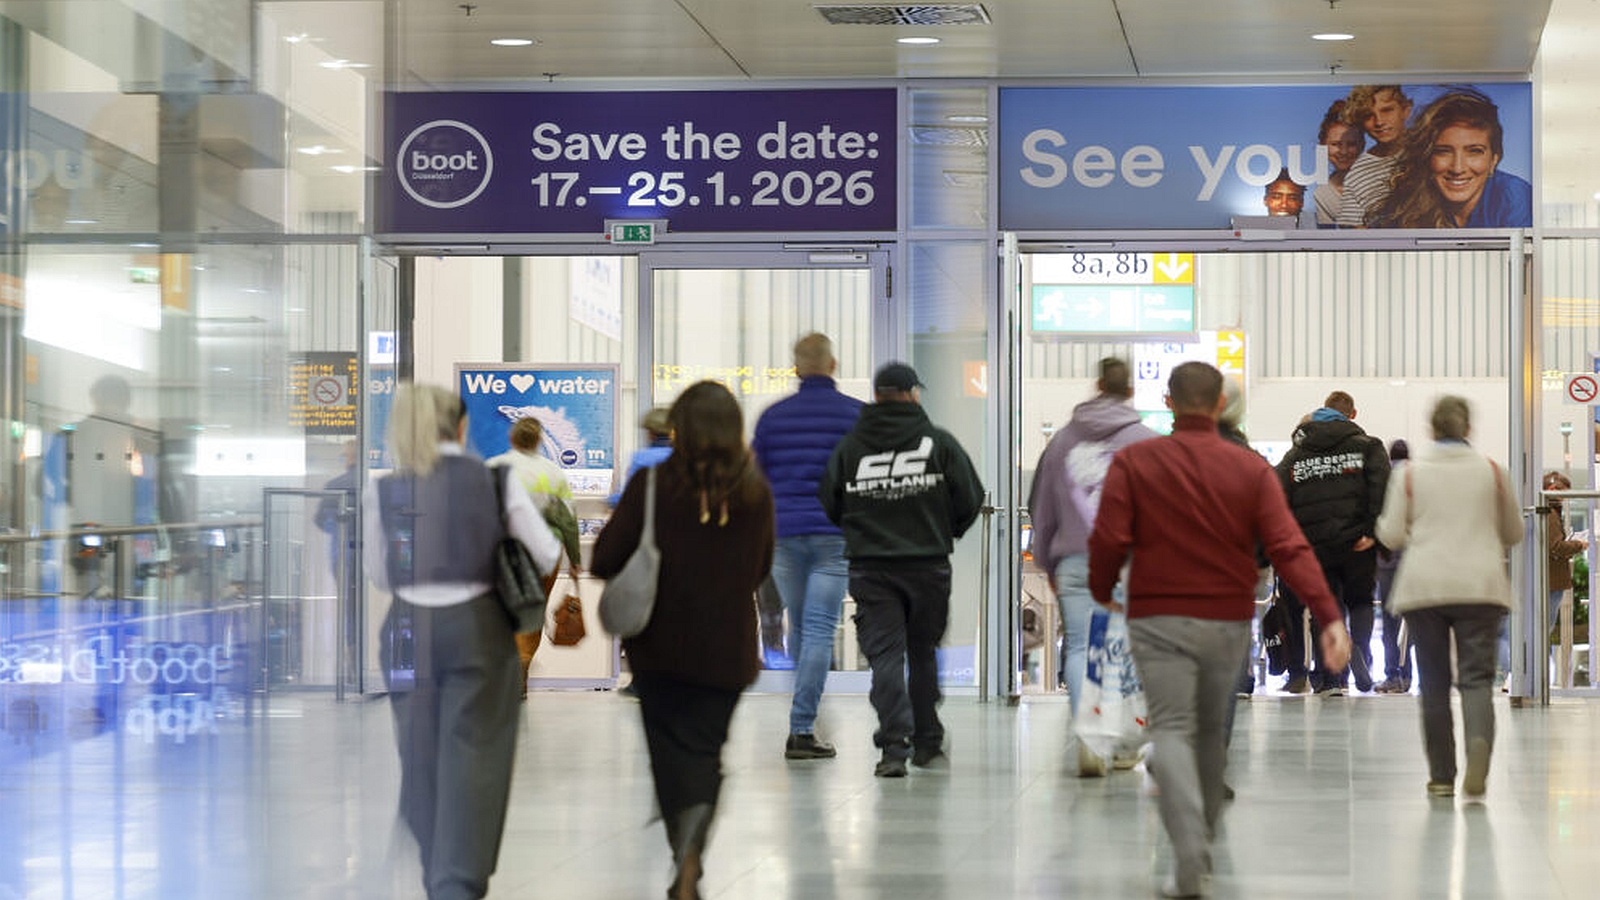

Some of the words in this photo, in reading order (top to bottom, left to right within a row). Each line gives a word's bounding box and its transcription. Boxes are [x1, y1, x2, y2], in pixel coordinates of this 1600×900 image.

[531, 122, 647, 160] Save
[661, 121, 742, 160] the
[757, 121, 879, 160] date:
[412, 150, 478, 170] boot
[1019, 129, 1164, 188] See
[1188, 144, 1328, 201] you
[752, 170, 875, 206] 2026
[465, 374, 507, 394] We
[538, 376, 610, 394] water
